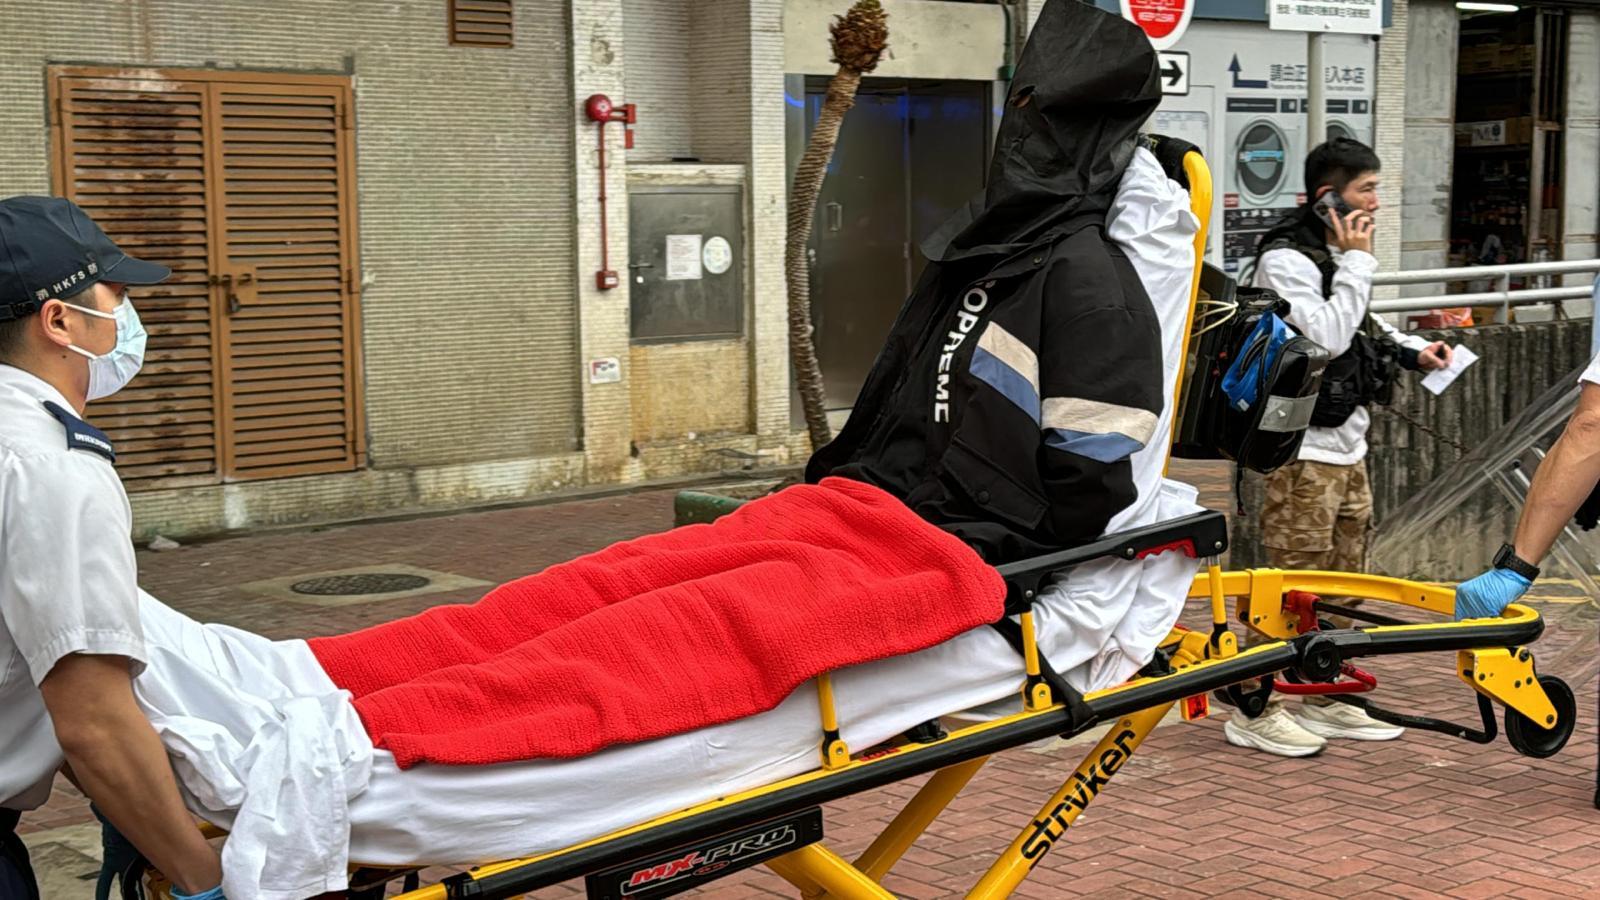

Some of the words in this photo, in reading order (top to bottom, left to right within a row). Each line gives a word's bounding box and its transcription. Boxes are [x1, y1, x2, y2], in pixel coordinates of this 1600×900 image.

[52, 270, 86, 294] HKFS
[1021, 729, 1136, 871] stryker
[628, 824, 793, 887] MX-PRO
